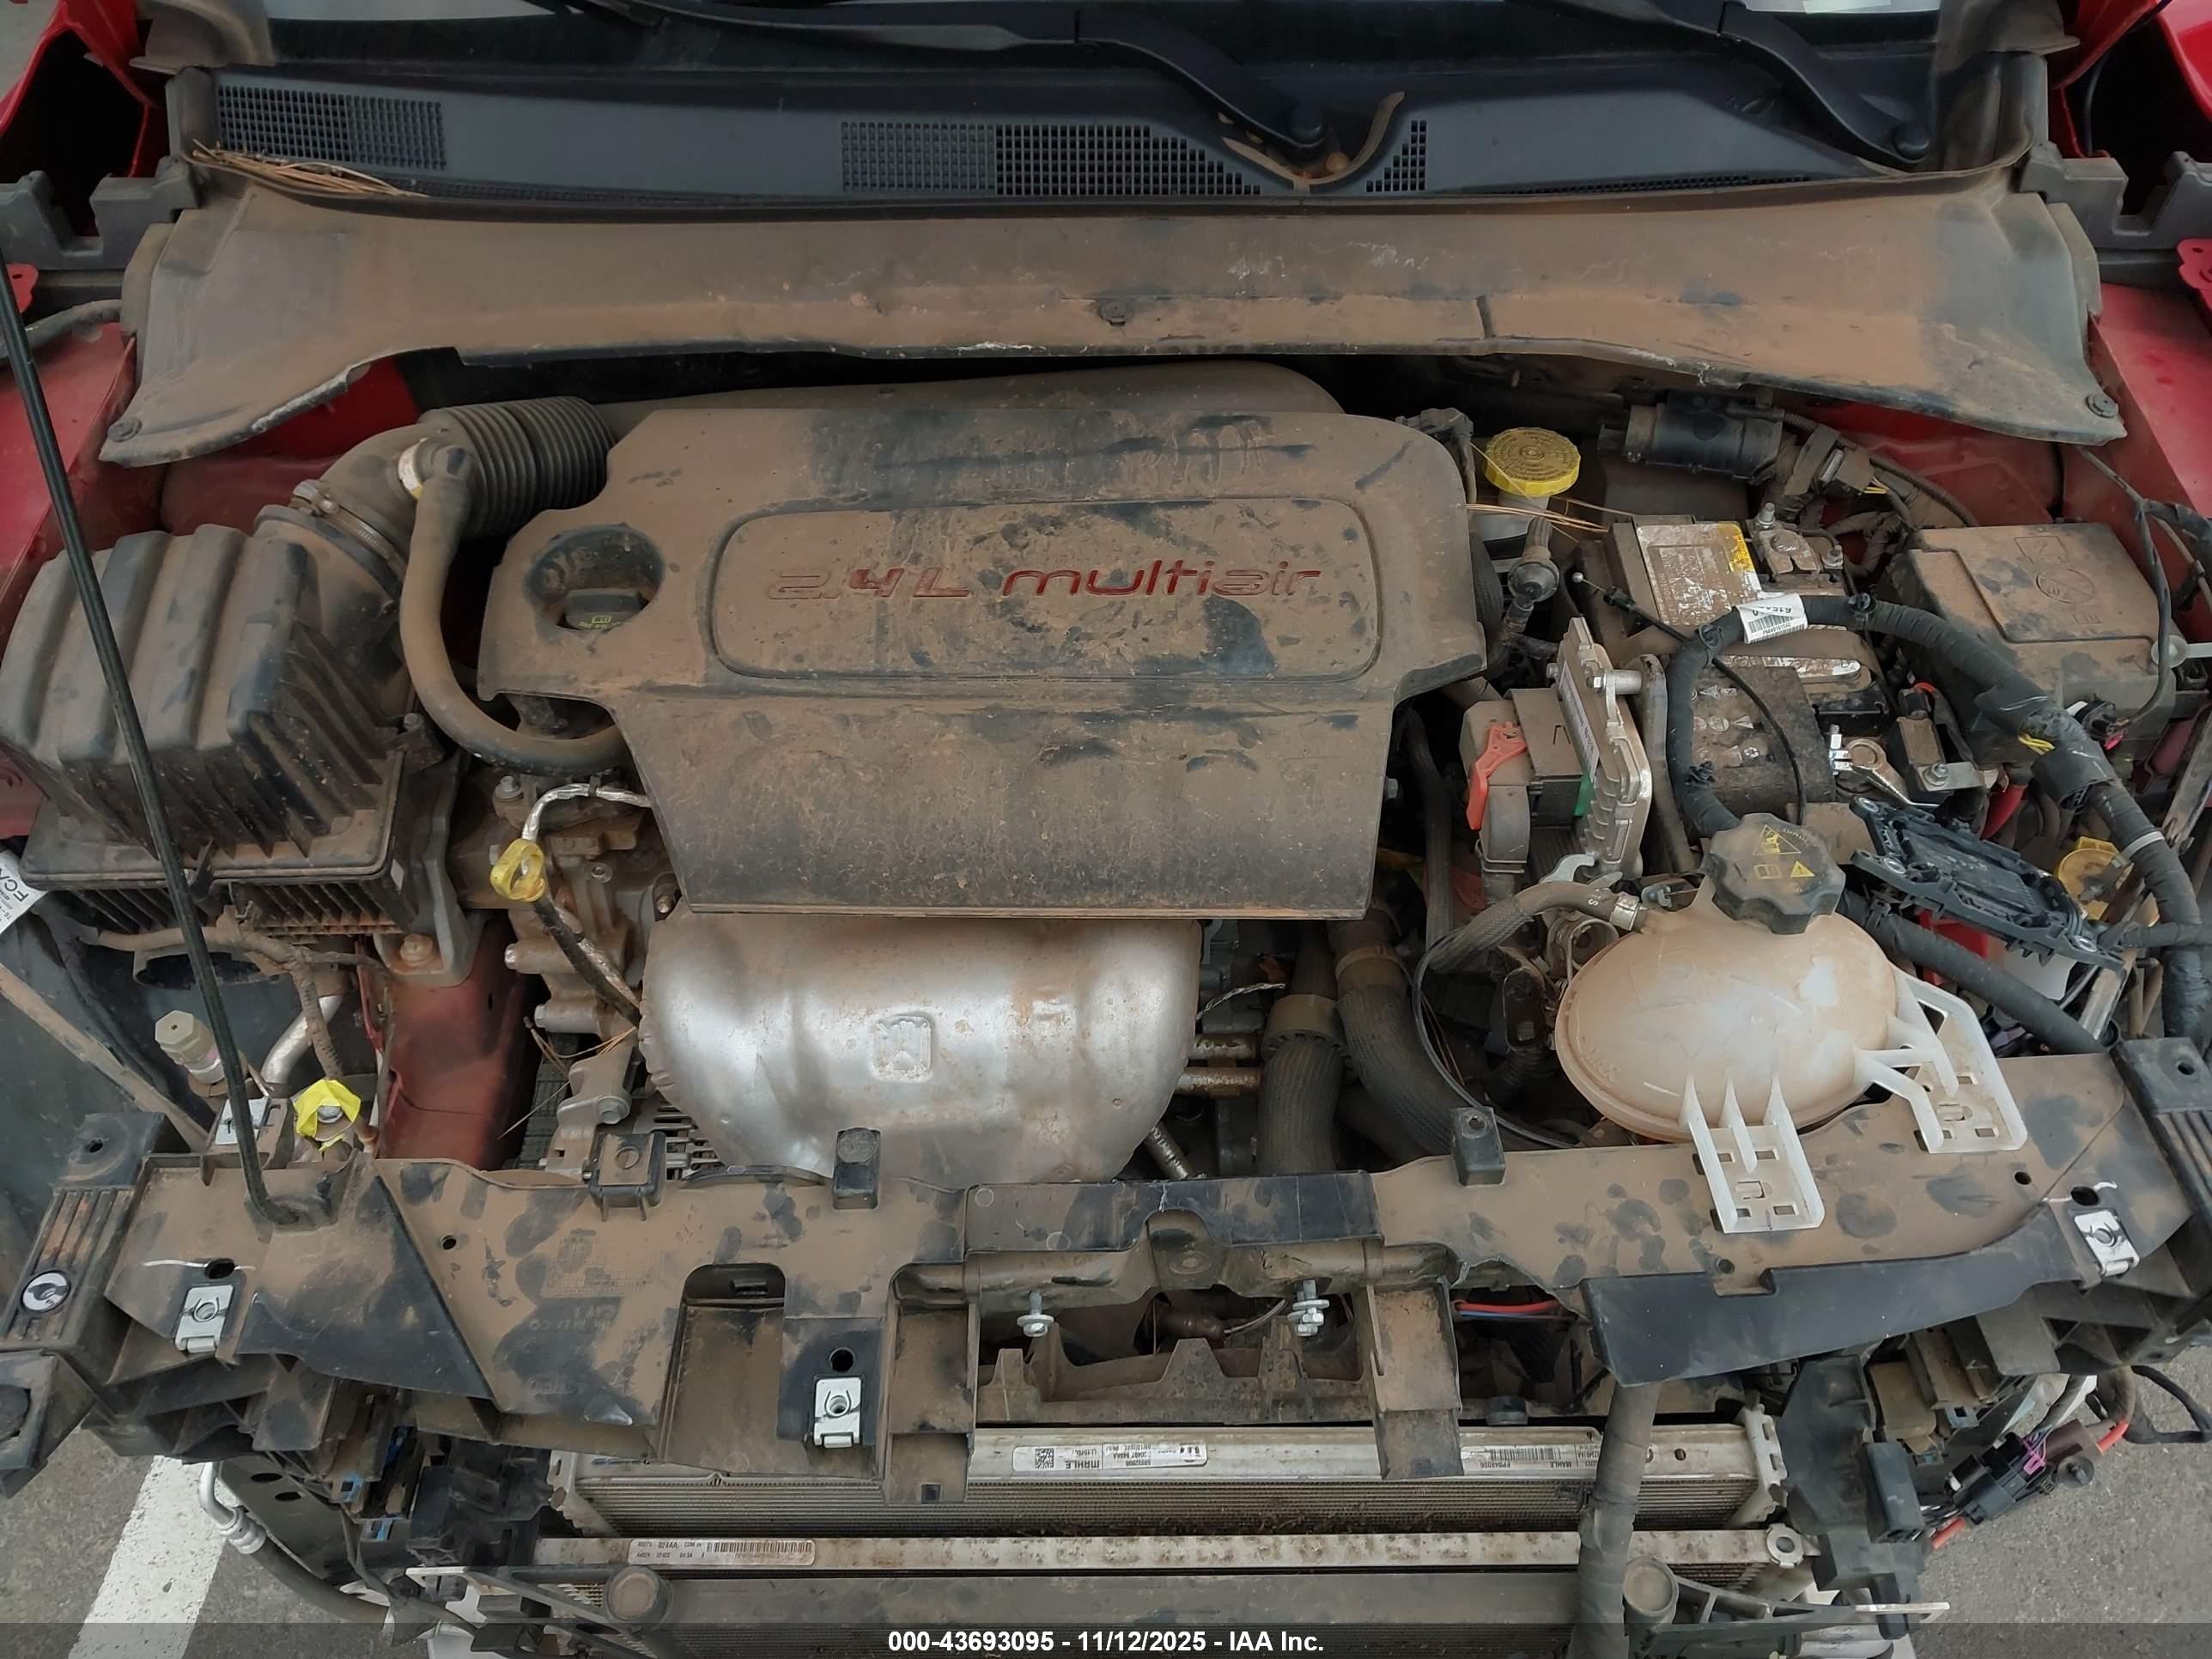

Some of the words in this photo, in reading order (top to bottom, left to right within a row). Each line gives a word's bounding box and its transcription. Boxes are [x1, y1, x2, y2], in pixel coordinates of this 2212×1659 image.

[768, 566, 969, 600] 2.4L
[1002, 560, 1322, 598] multiair
[1065, 1460, 1100, 1469] MAHLE
